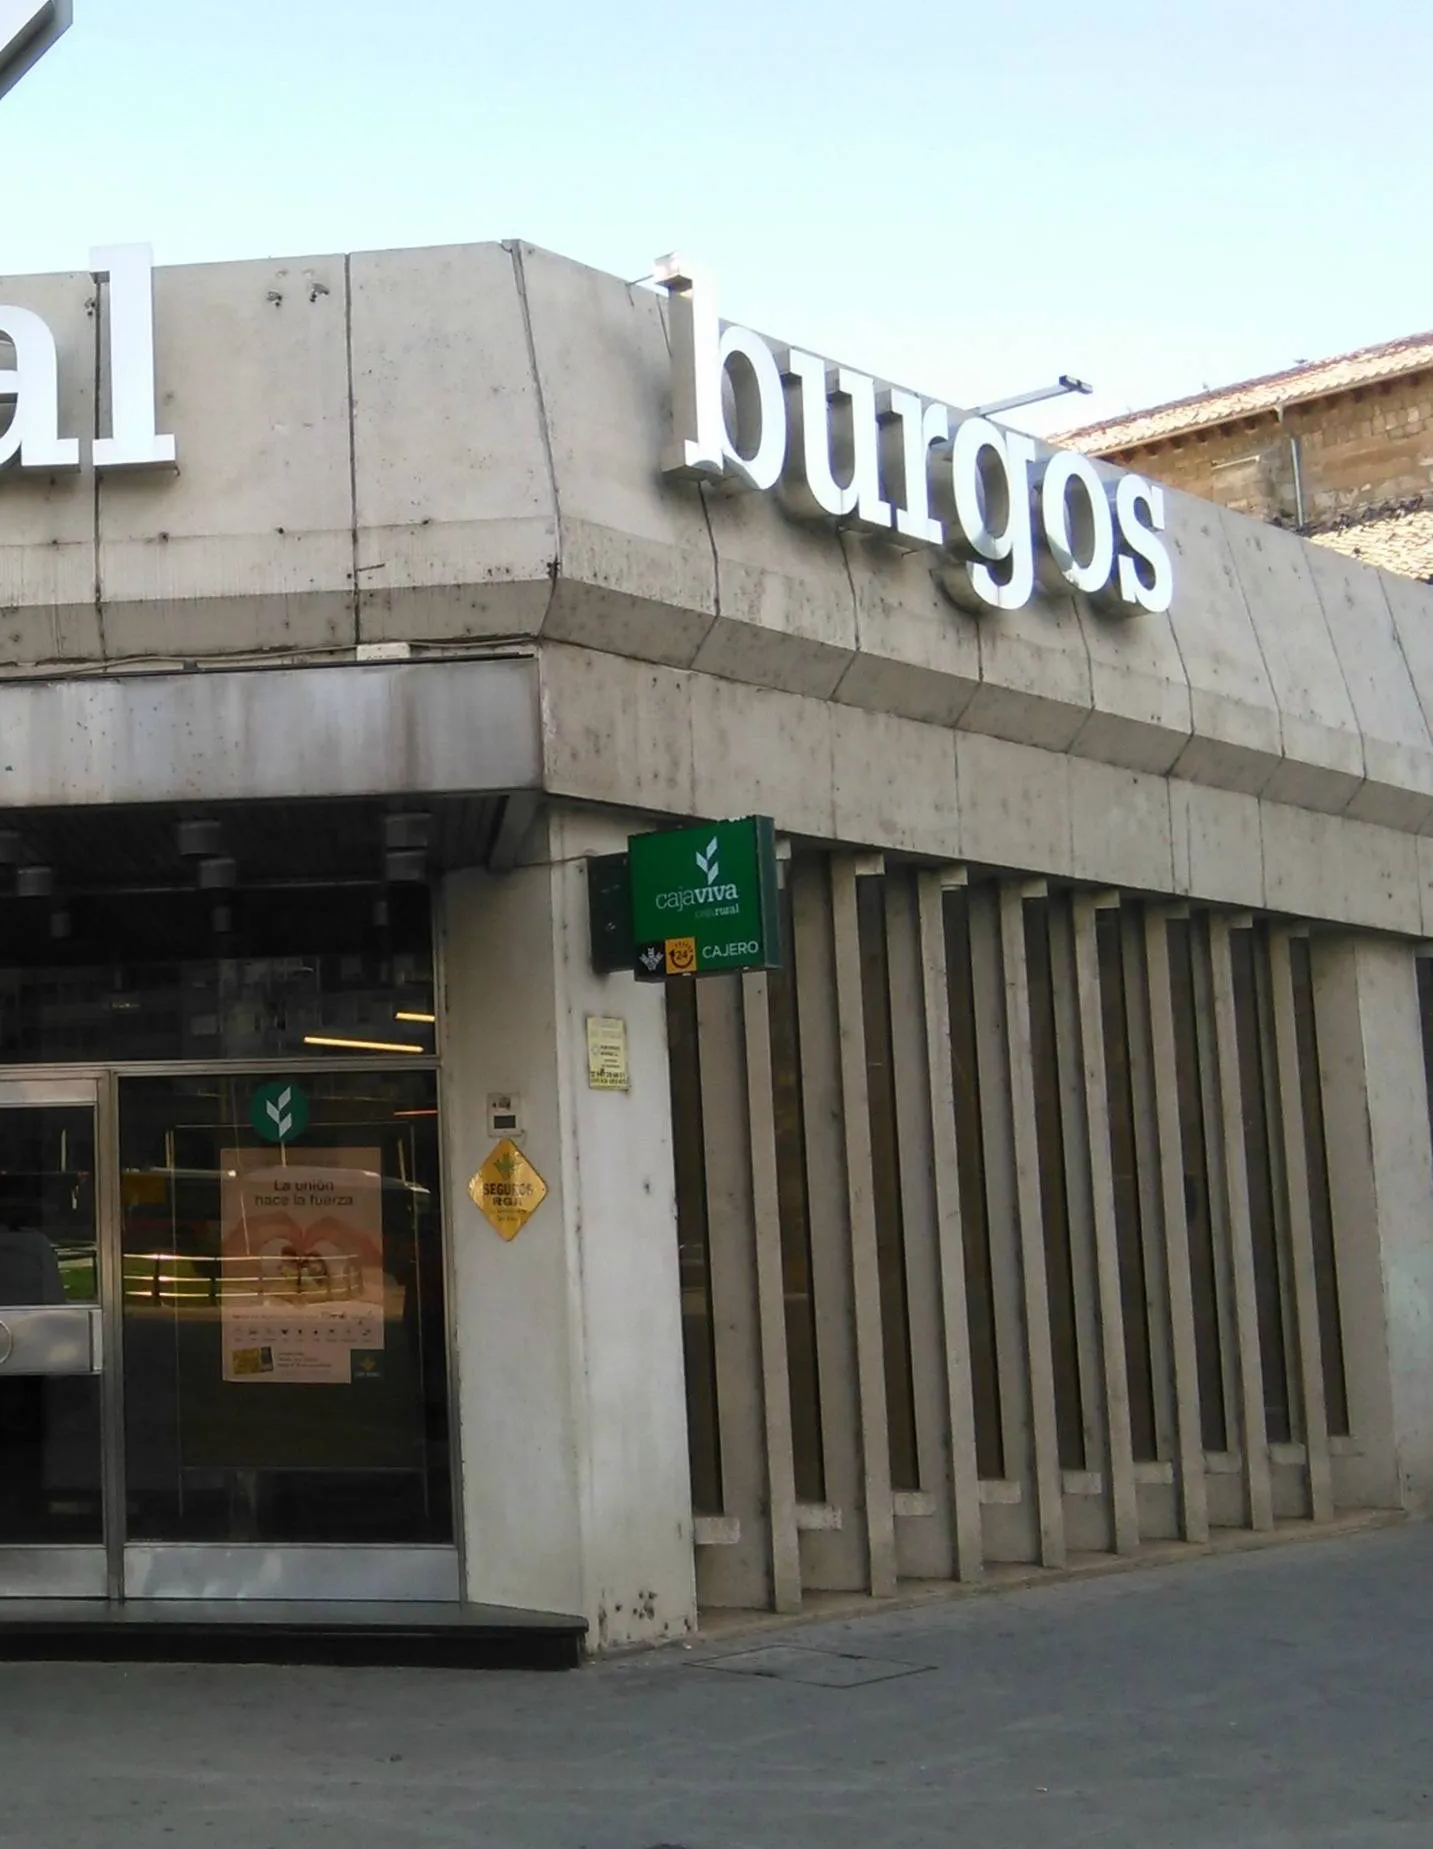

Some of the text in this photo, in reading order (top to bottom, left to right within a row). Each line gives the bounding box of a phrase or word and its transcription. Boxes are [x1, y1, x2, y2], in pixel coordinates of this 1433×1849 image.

[655, 252, 1174, 613] burgos
[655, 883, 739, 912] cajaviva
[702, 941, 759, 959] CAJERO
[274, 1180, 291, 1192] La
[255, 1194, 354, 1206] hace la fuerza
